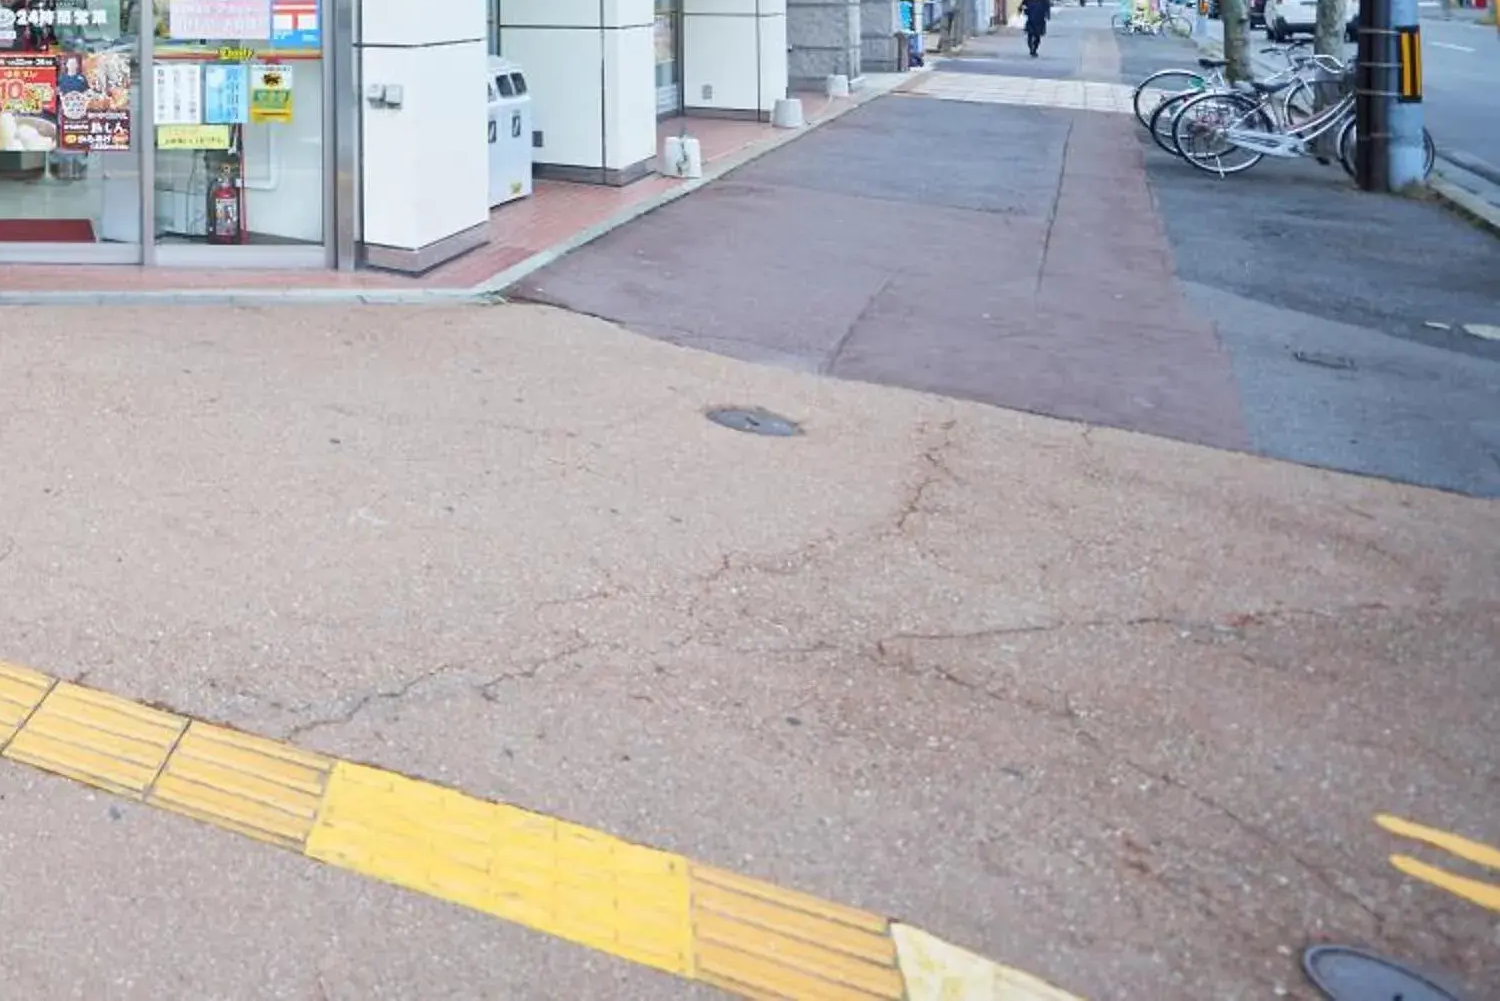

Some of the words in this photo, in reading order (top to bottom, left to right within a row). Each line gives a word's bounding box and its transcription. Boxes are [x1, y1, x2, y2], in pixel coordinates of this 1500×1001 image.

[15, 7, 107, 27] 24時間営業
[218, 46, 253, 60] Daily
